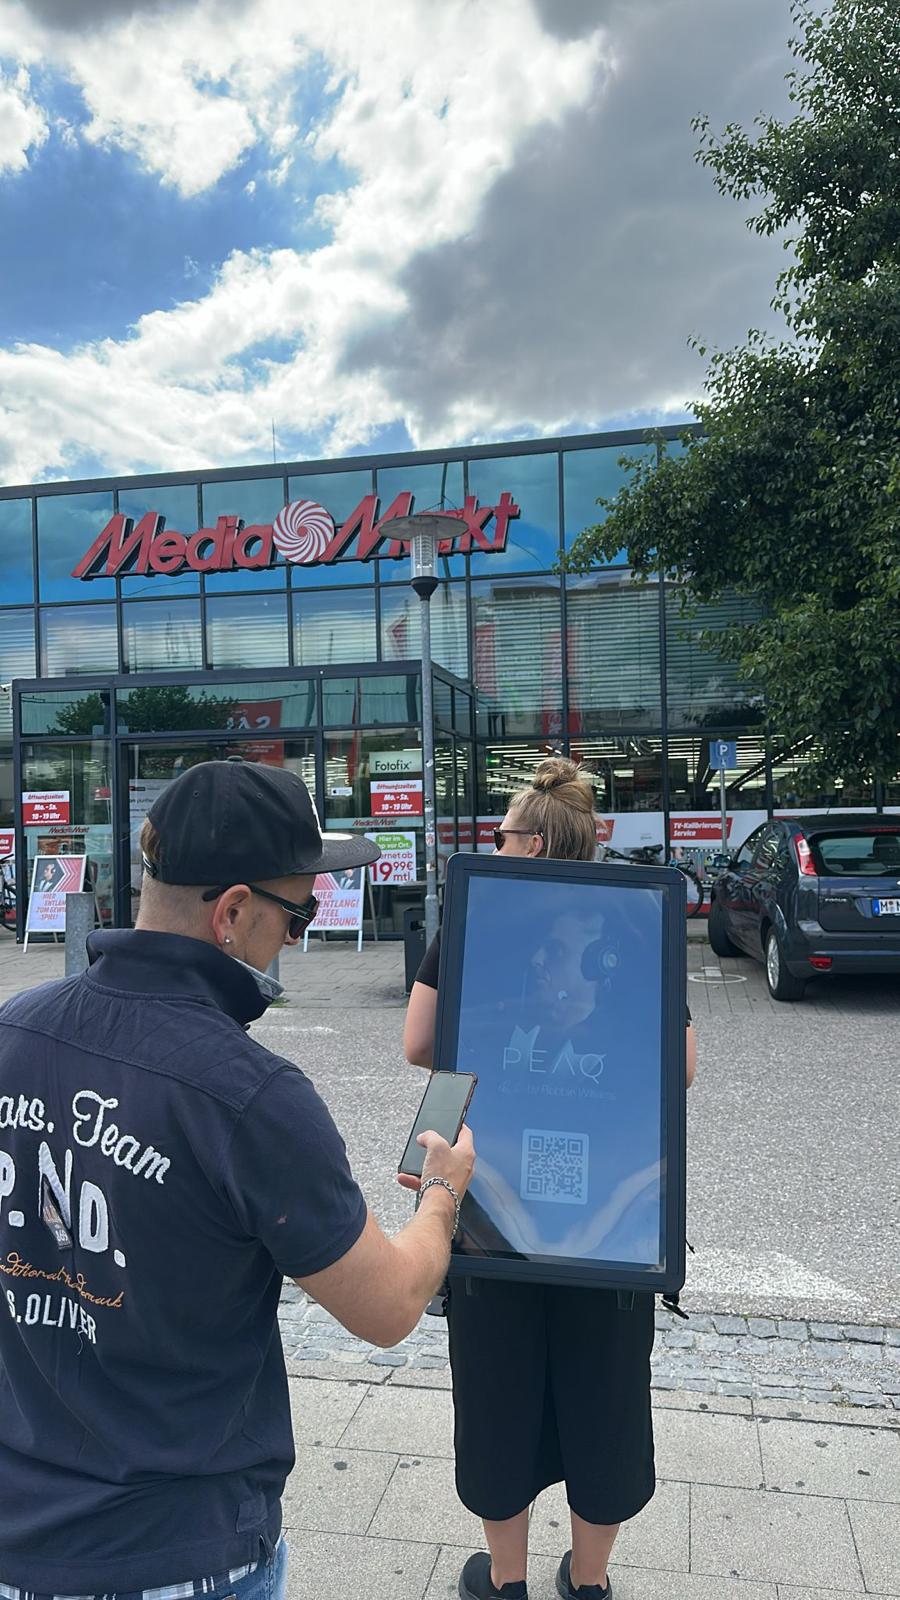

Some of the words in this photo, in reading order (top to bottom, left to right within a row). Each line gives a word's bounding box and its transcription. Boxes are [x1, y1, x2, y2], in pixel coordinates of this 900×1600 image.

[71, 512, 276, 579] Media
[719, 744, 728, 755] P
[673, 821, 729, 830] TV-Kalibrierung-
[673, 829, 697, 837] Service
[402, 851, 413, 859] ab
[369, 861, 393, 882] 19
[393, 861, 414, 871] 99€
[393, 872, 414, 881] mtl.
[503, 1046, 607, 1084] PEAQ
[0, 1094, 55, 1133] ars.
[72, 1089, 172, 1184] Team
[6, 1289, 97, 1344] S.OLIVER
